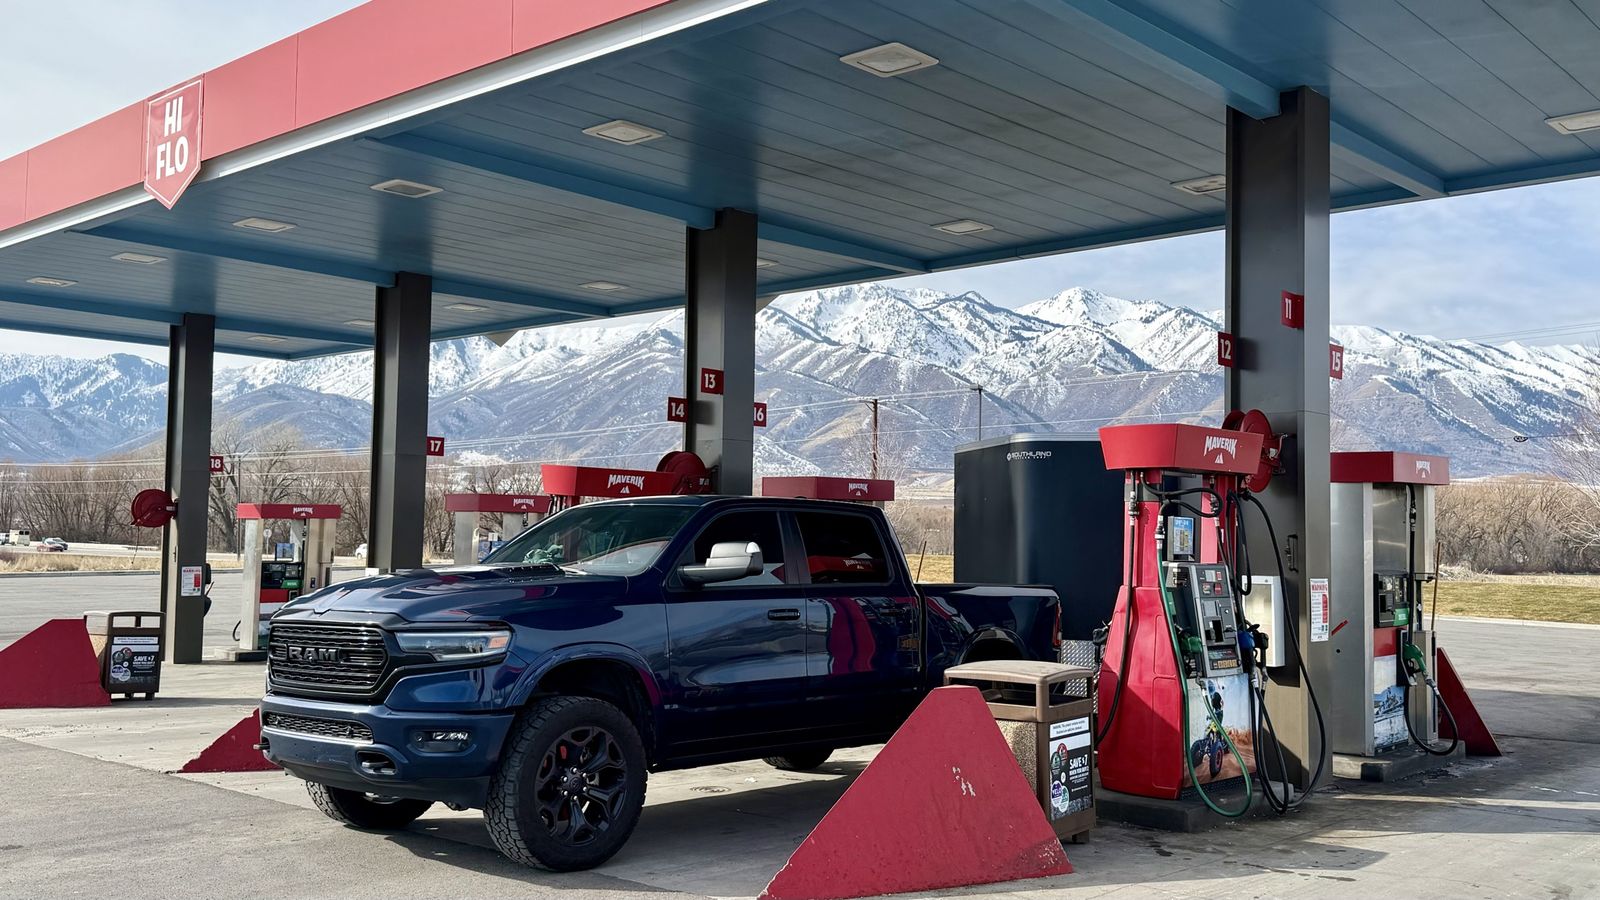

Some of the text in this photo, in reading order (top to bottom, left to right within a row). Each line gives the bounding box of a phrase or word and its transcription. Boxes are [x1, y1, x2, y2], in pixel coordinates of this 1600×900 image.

[164, 96, 184, 137] HI
[156, 136, 189, 181] FLO
[1285, 298, 1292, 320] 11
[1220, 338, 1231, 360] 12
[1332, 351, 1340, 372] 15
[704, 373, 716, 389] 13
[671, 402, 685, 417] 14
[753, 407, 764, 422] 16
[430, 440, 442, 452] 17
[1203, 435, 1238, 459] MAVERIK
[210, 458, 221, 469] 18
[607, 474, 645, 490] MAVERIK
[288, 646, 337, 662] RAM
[1069, 757, 1082, 769] SAVE
